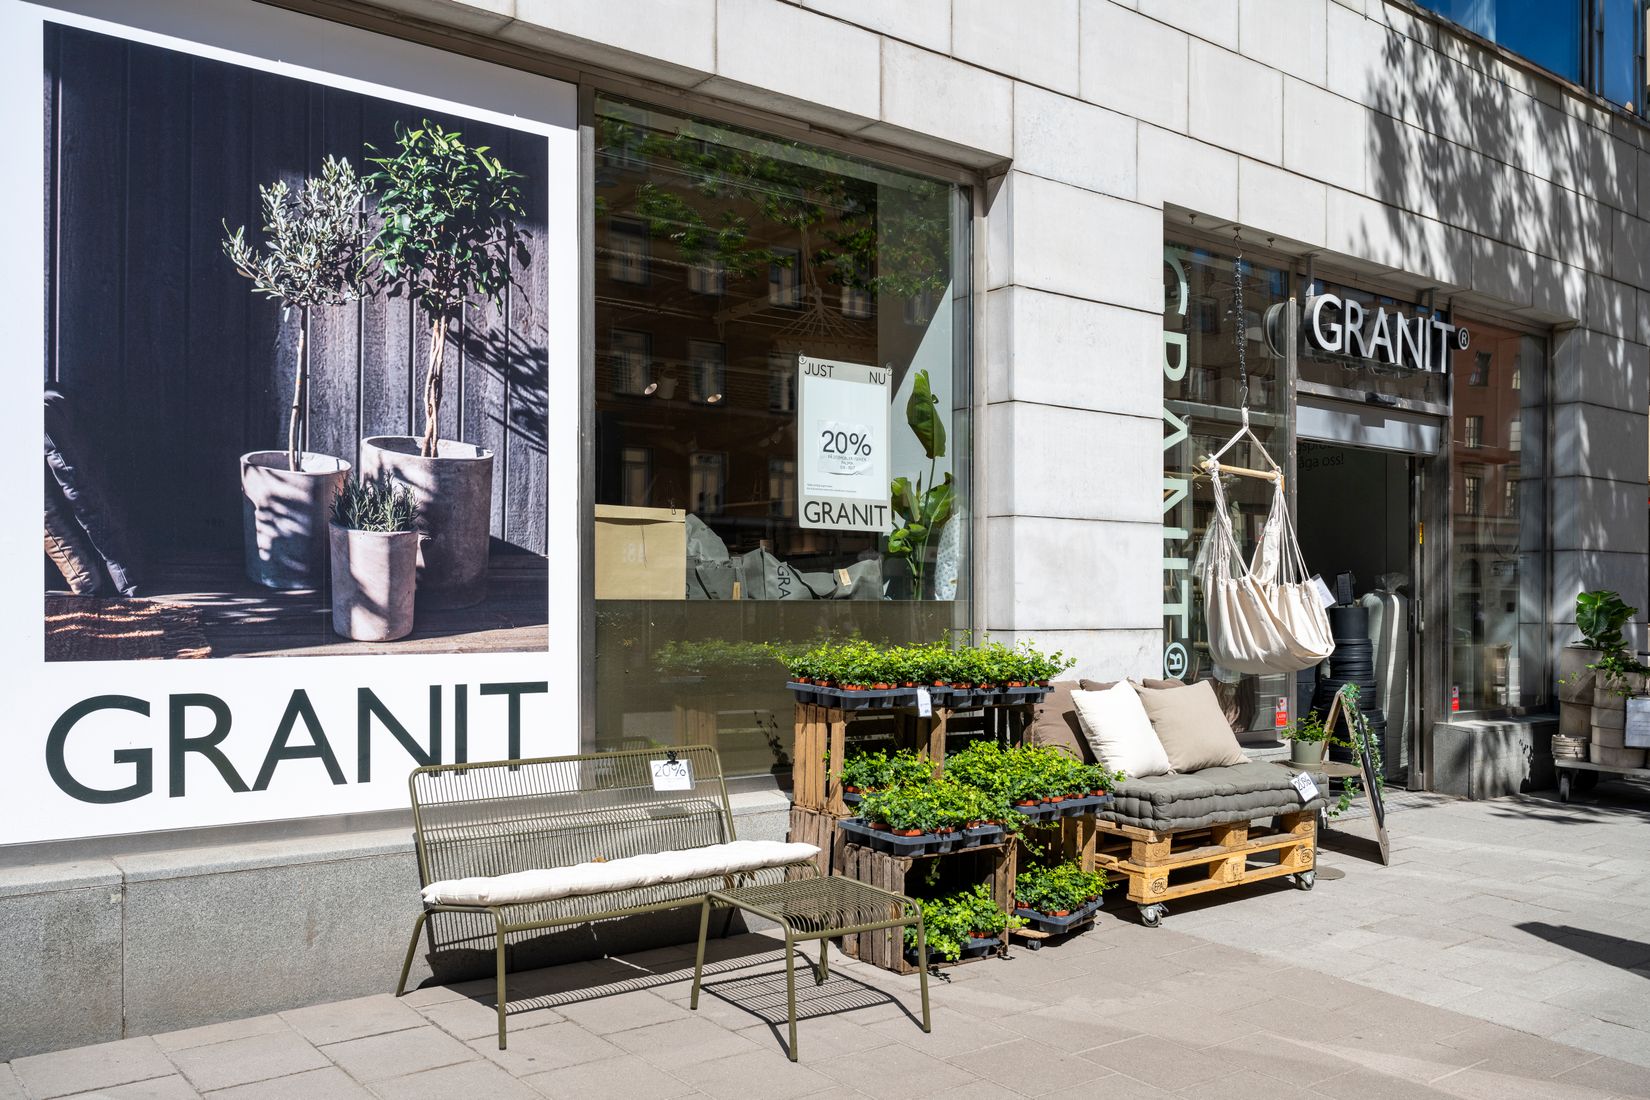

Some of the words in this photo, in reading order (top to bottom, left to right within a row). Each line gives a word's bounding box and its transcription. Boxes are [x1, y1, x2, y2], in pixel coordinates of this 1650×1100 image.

[804, 363, 834, 378] JUST
[869, 371, 886, 385] NU
[821, 430, 872, 456] 20%
[1322, 451, 1344, 467] oss!
[804, 501, 887, 527] GRANIT
[45, 681, 548, 804] GRANIT
[654, 763, 687, 777] 20%
[1295, 776, 1311, 791] 20%
